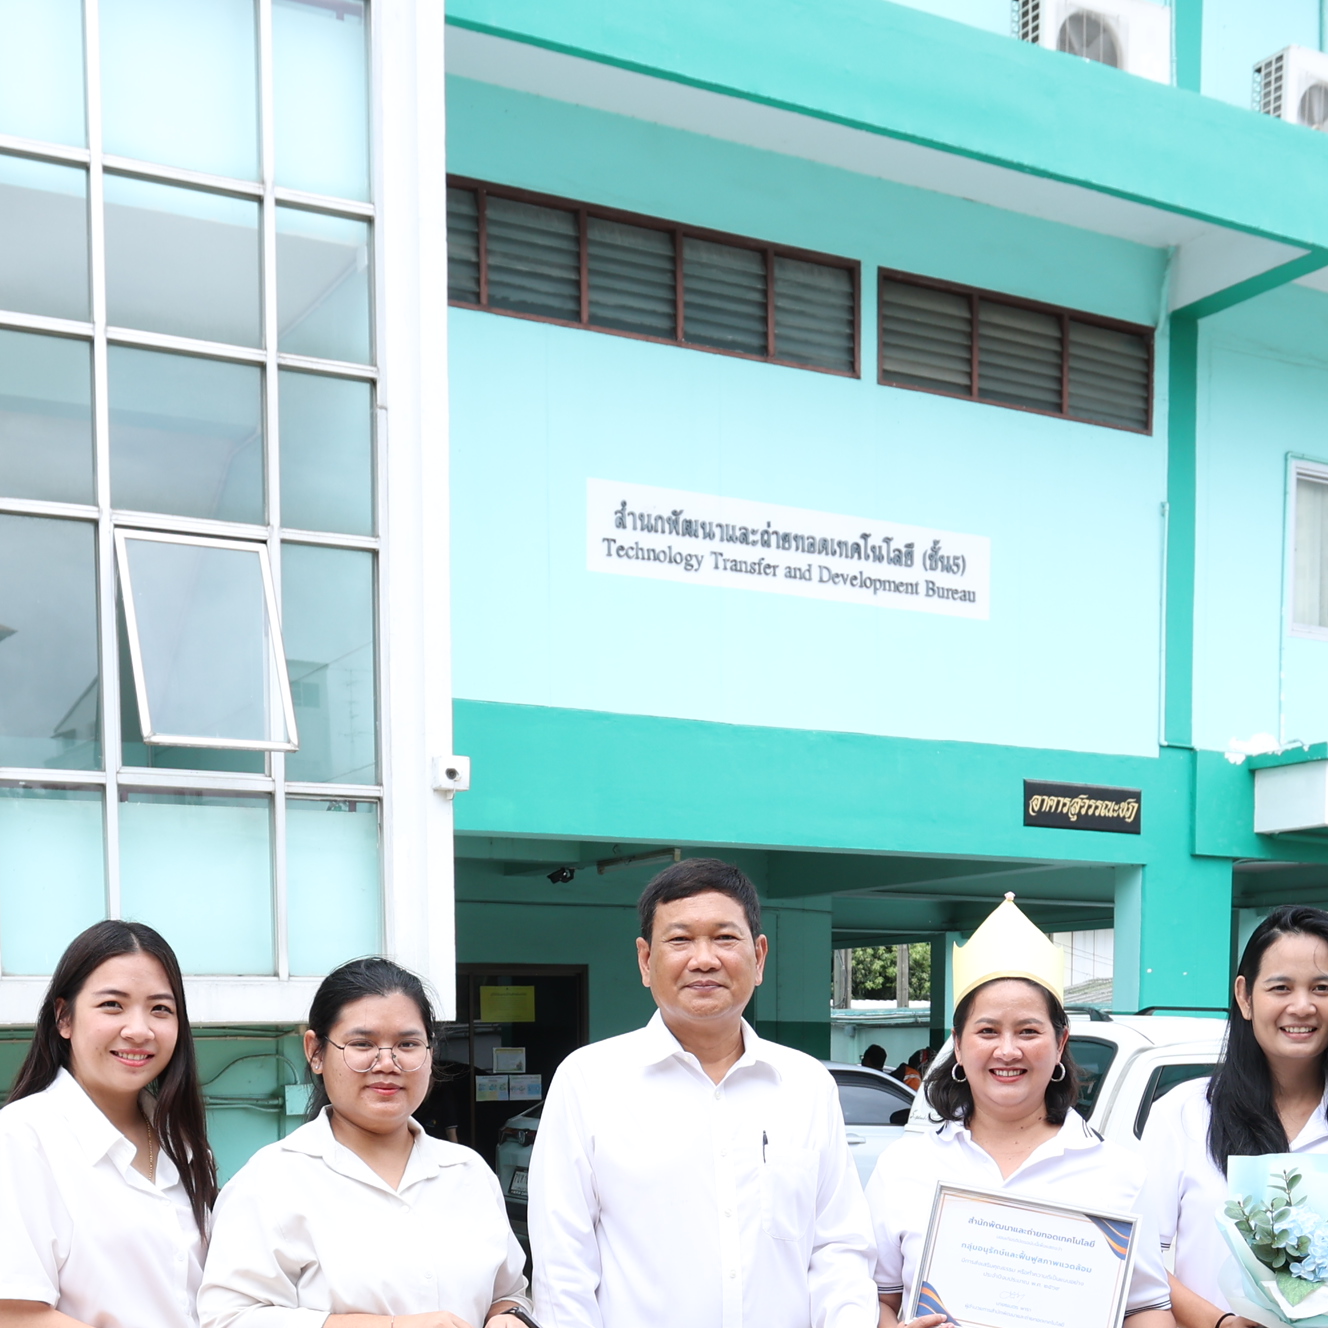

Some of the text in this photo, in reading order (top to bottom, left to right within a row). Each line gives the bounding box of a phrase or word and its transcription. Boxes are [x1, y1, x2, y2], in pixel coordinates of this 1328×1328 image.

[602, 537, 977, 603] Technology Transfer and Development Bureau
[968, 1215, 1095, 1248] สำนักพัฒนาและถ่ายทอดเทคโนโลยี
[960, 1240, 1092, 1274] กลุ่มอนุรักษ์และฟื้นฟูสภาพแวดล้อม
